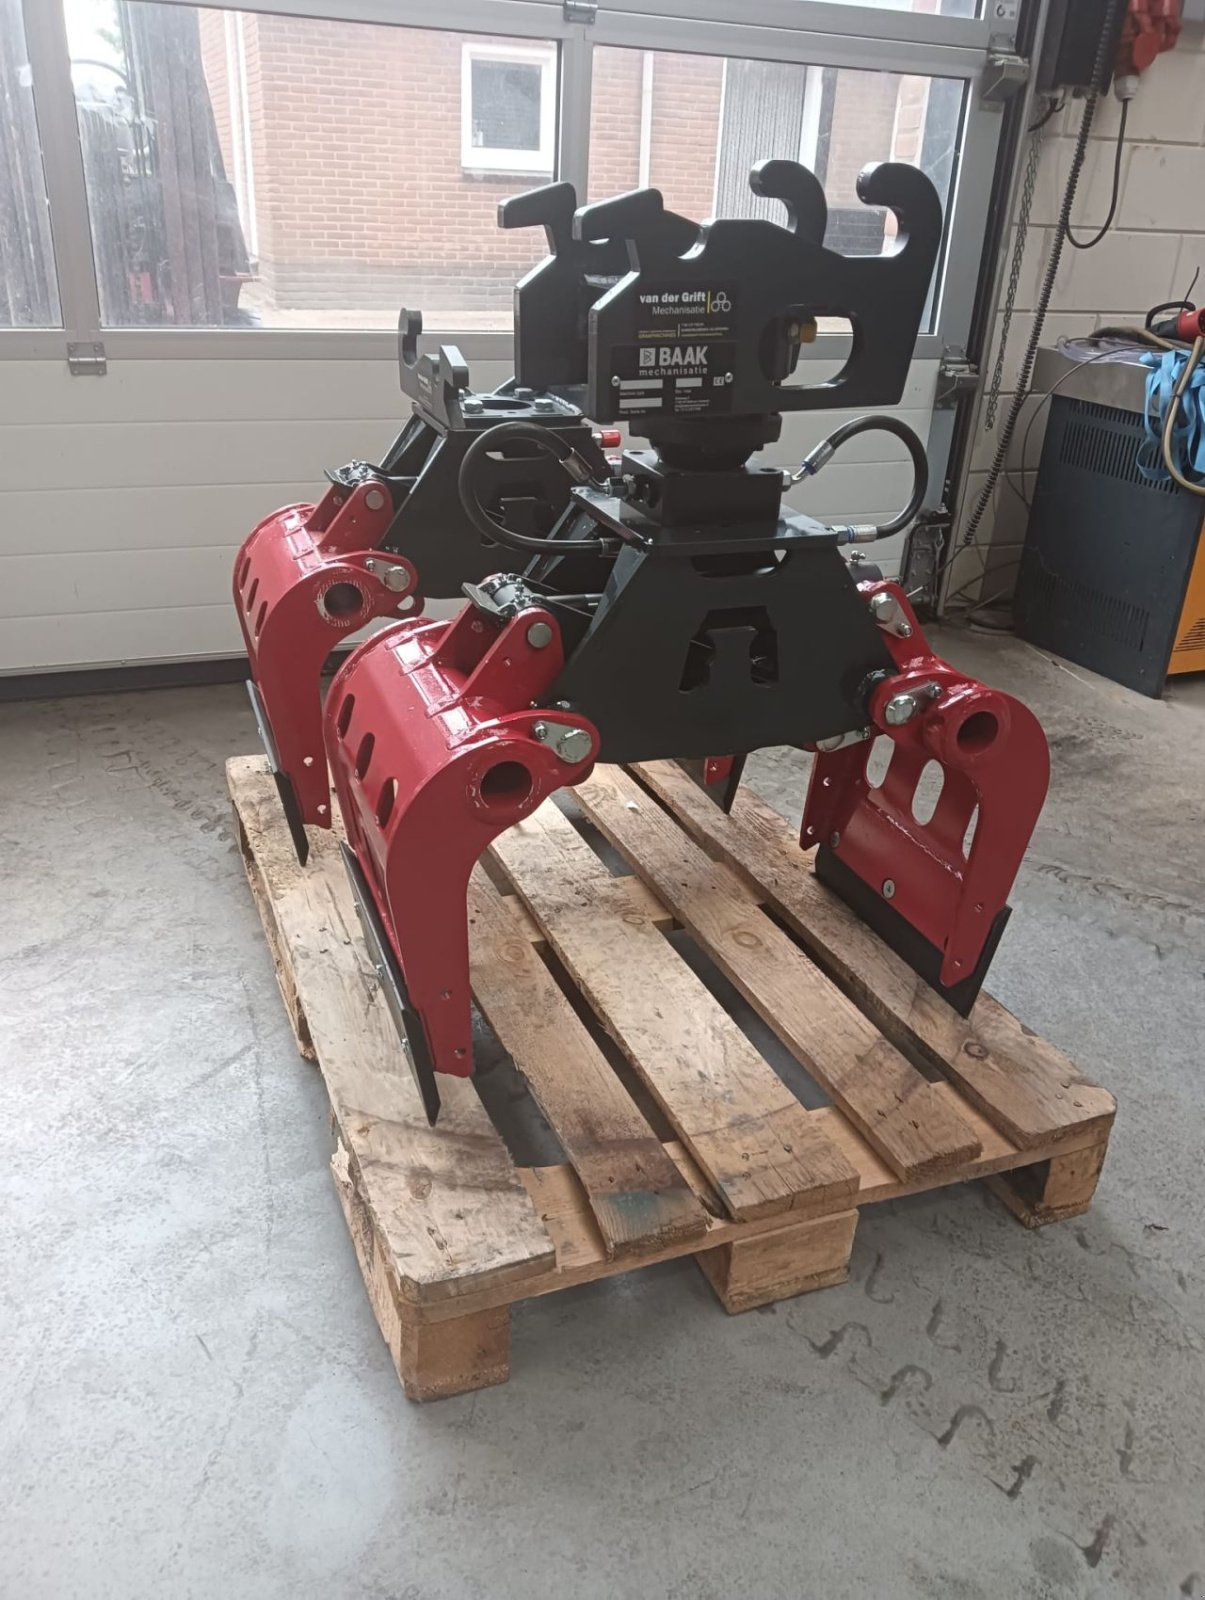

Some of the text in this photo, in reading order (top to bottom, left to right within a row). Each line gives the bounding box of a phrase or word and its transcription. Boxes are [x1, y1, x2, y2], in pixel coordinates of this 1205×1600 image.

[639, 291, 706, 304] van der Grift
[652, 306, 705, 315] Mechanisatie
[658, 346, 708, 366] BAAK
[639, 366, 708, 376] mechanisatie
